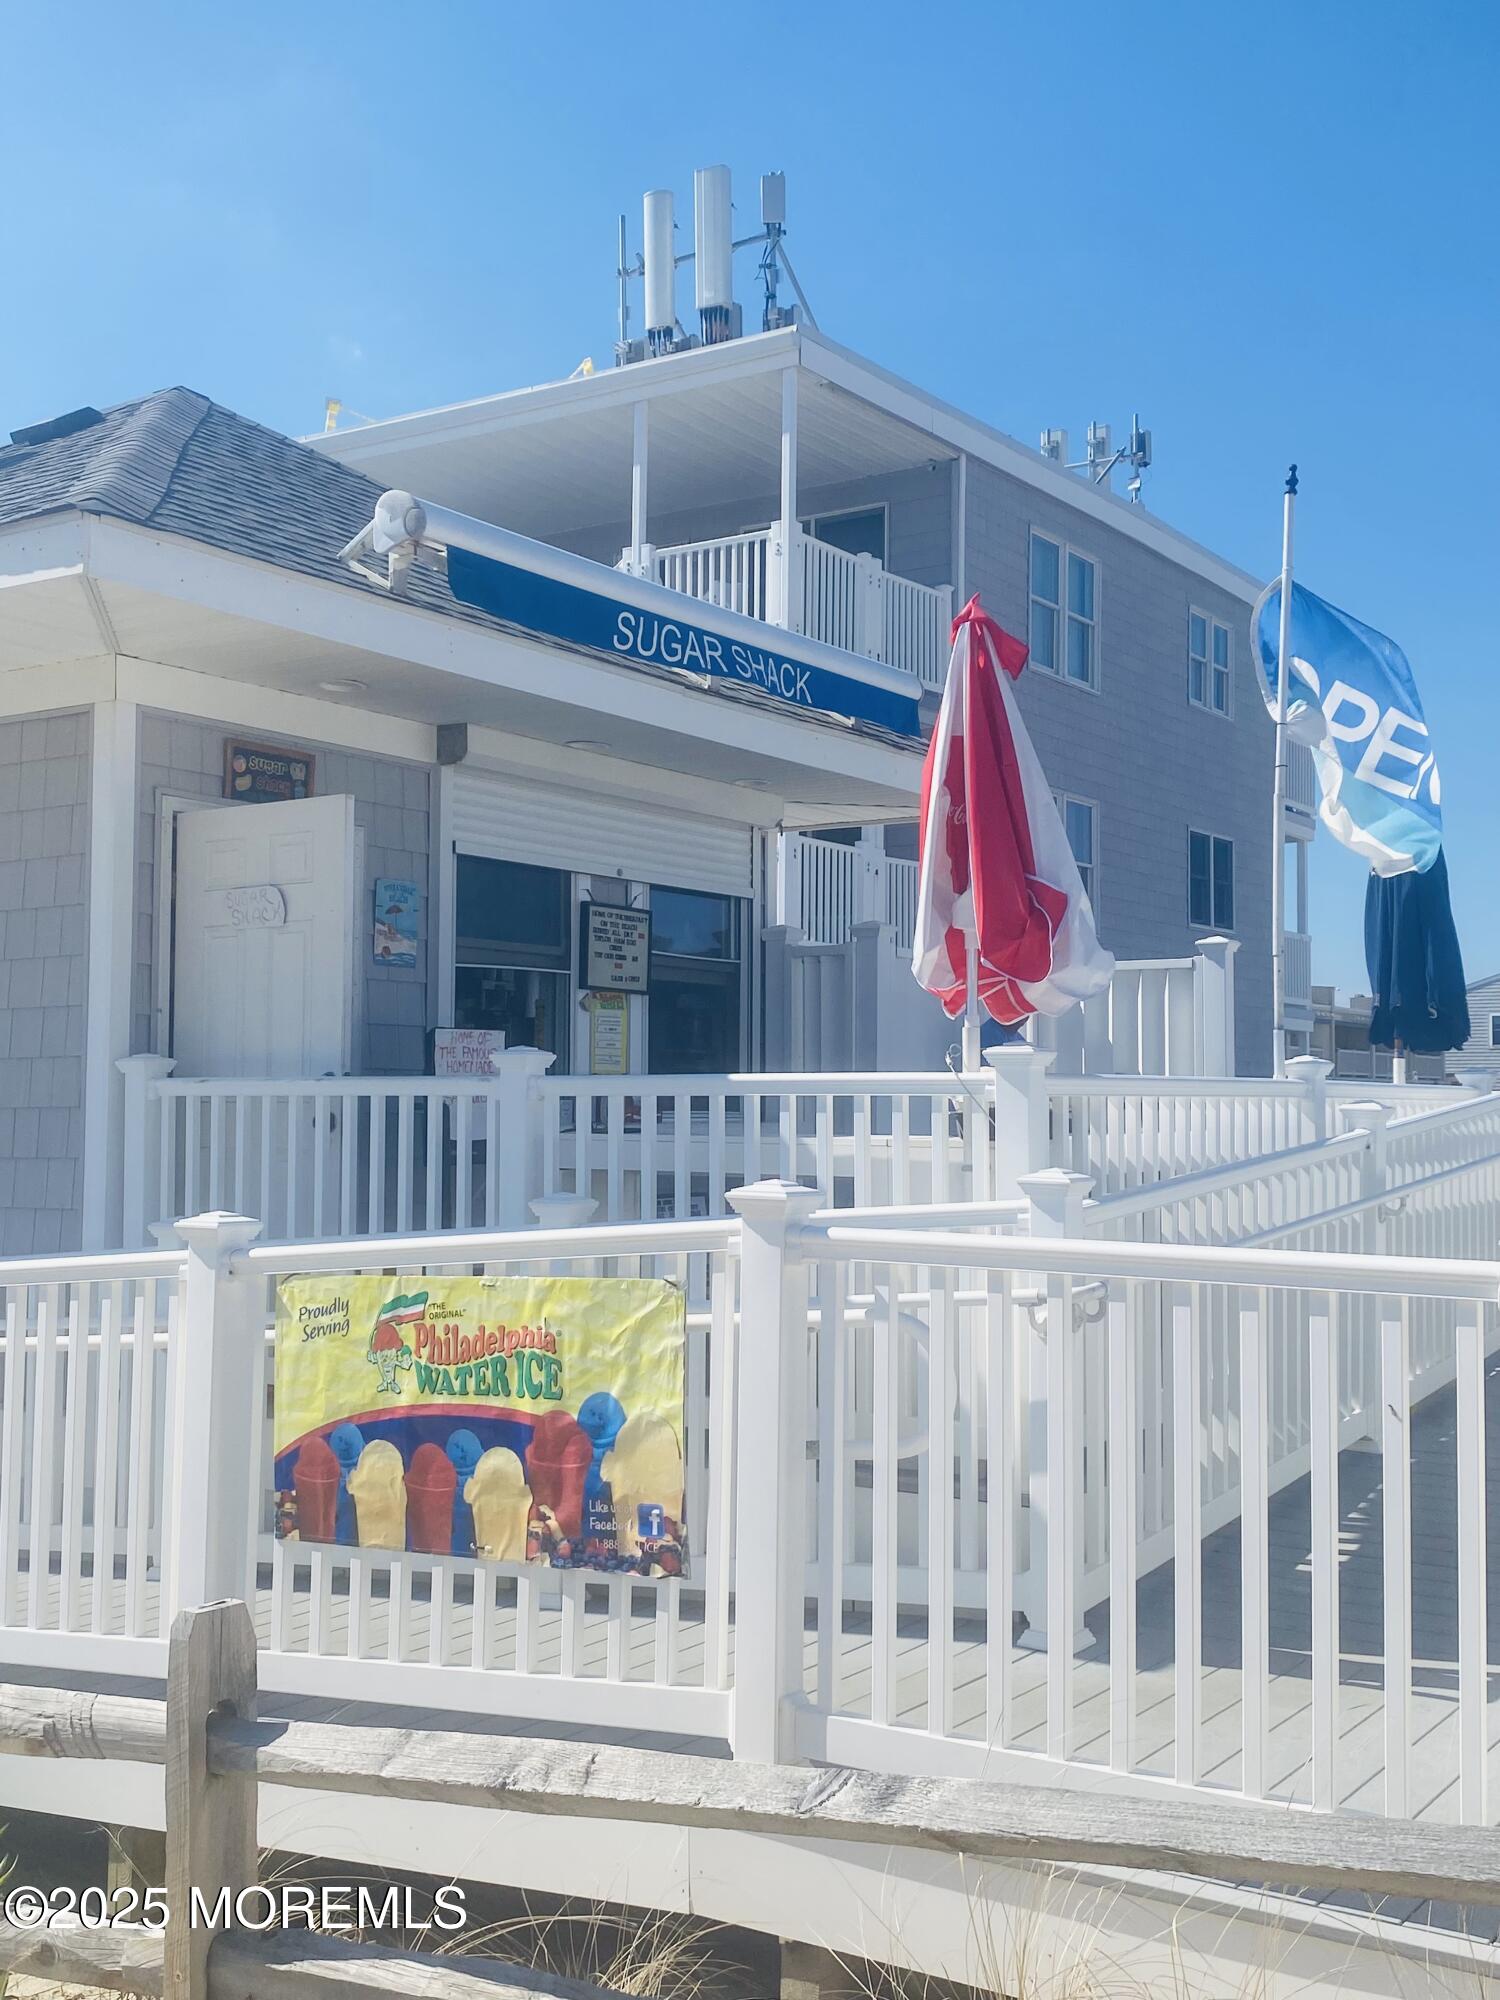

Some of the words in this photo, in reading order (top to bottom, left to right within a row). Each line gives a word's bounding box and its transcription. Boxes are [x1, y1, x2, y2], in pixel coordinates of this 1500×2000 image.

[613, 611, 729, 673] SUGAR
[731, 645, 813, 704] SHACK
[477, 1031, 493, 1045] OF
[439, 1046, 457, 1059] THE
[298, 1296, 350, 1322] Proudly
[301, 1318, 350, 1342] Serving
[413, 1322, 557, 1366] Philadelphia
[414, 1354, 511, 1397] WATER
[514, 1350, 563, 1400] ICE
[589, 1499, 609, 1512] Like
[589, 1516, 634, 1533] Faceb
